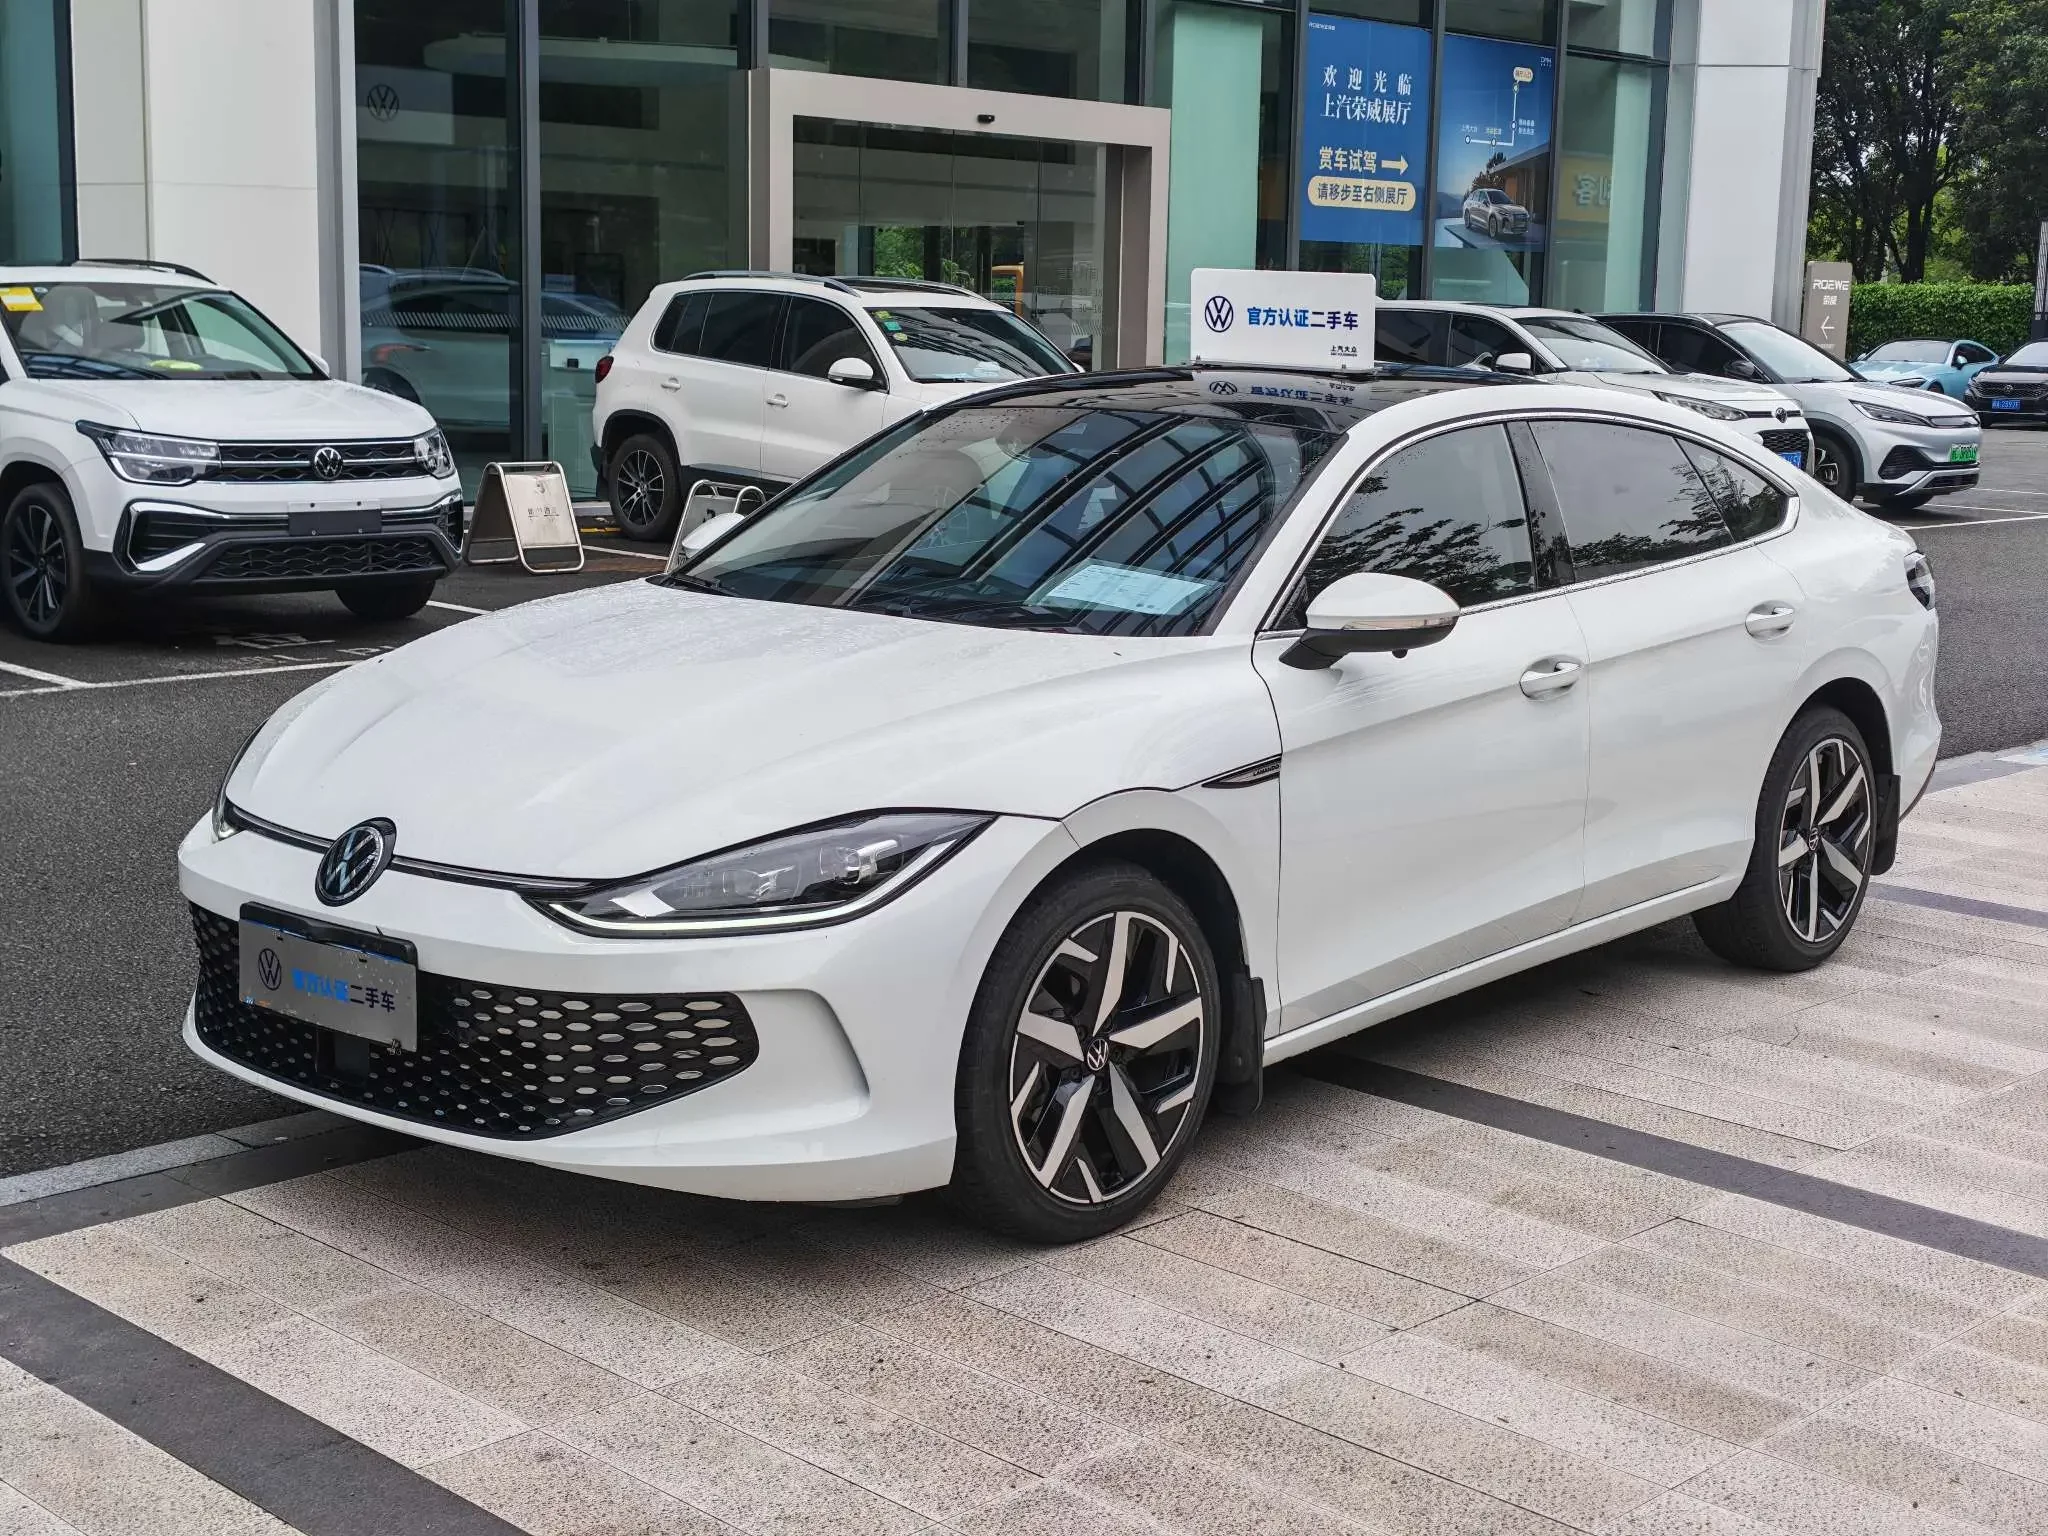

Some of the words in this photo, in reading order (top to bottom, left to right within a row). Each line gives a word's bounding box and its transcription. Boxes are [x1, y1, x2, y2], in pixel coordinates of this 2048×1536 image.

[1322, 64, 1412, 96] 欢迎光临
[1320, 92, 1412, 125] 上汽荣威展厅
[1319, 146, 1377, 173] 赏车试驾
[1318, 182, 1408, 205] 请移步至右侧展厅
[1813, 279, 1850, 291] ROEWE
[1247, 307, 1358, 330] 官方认证二手车
